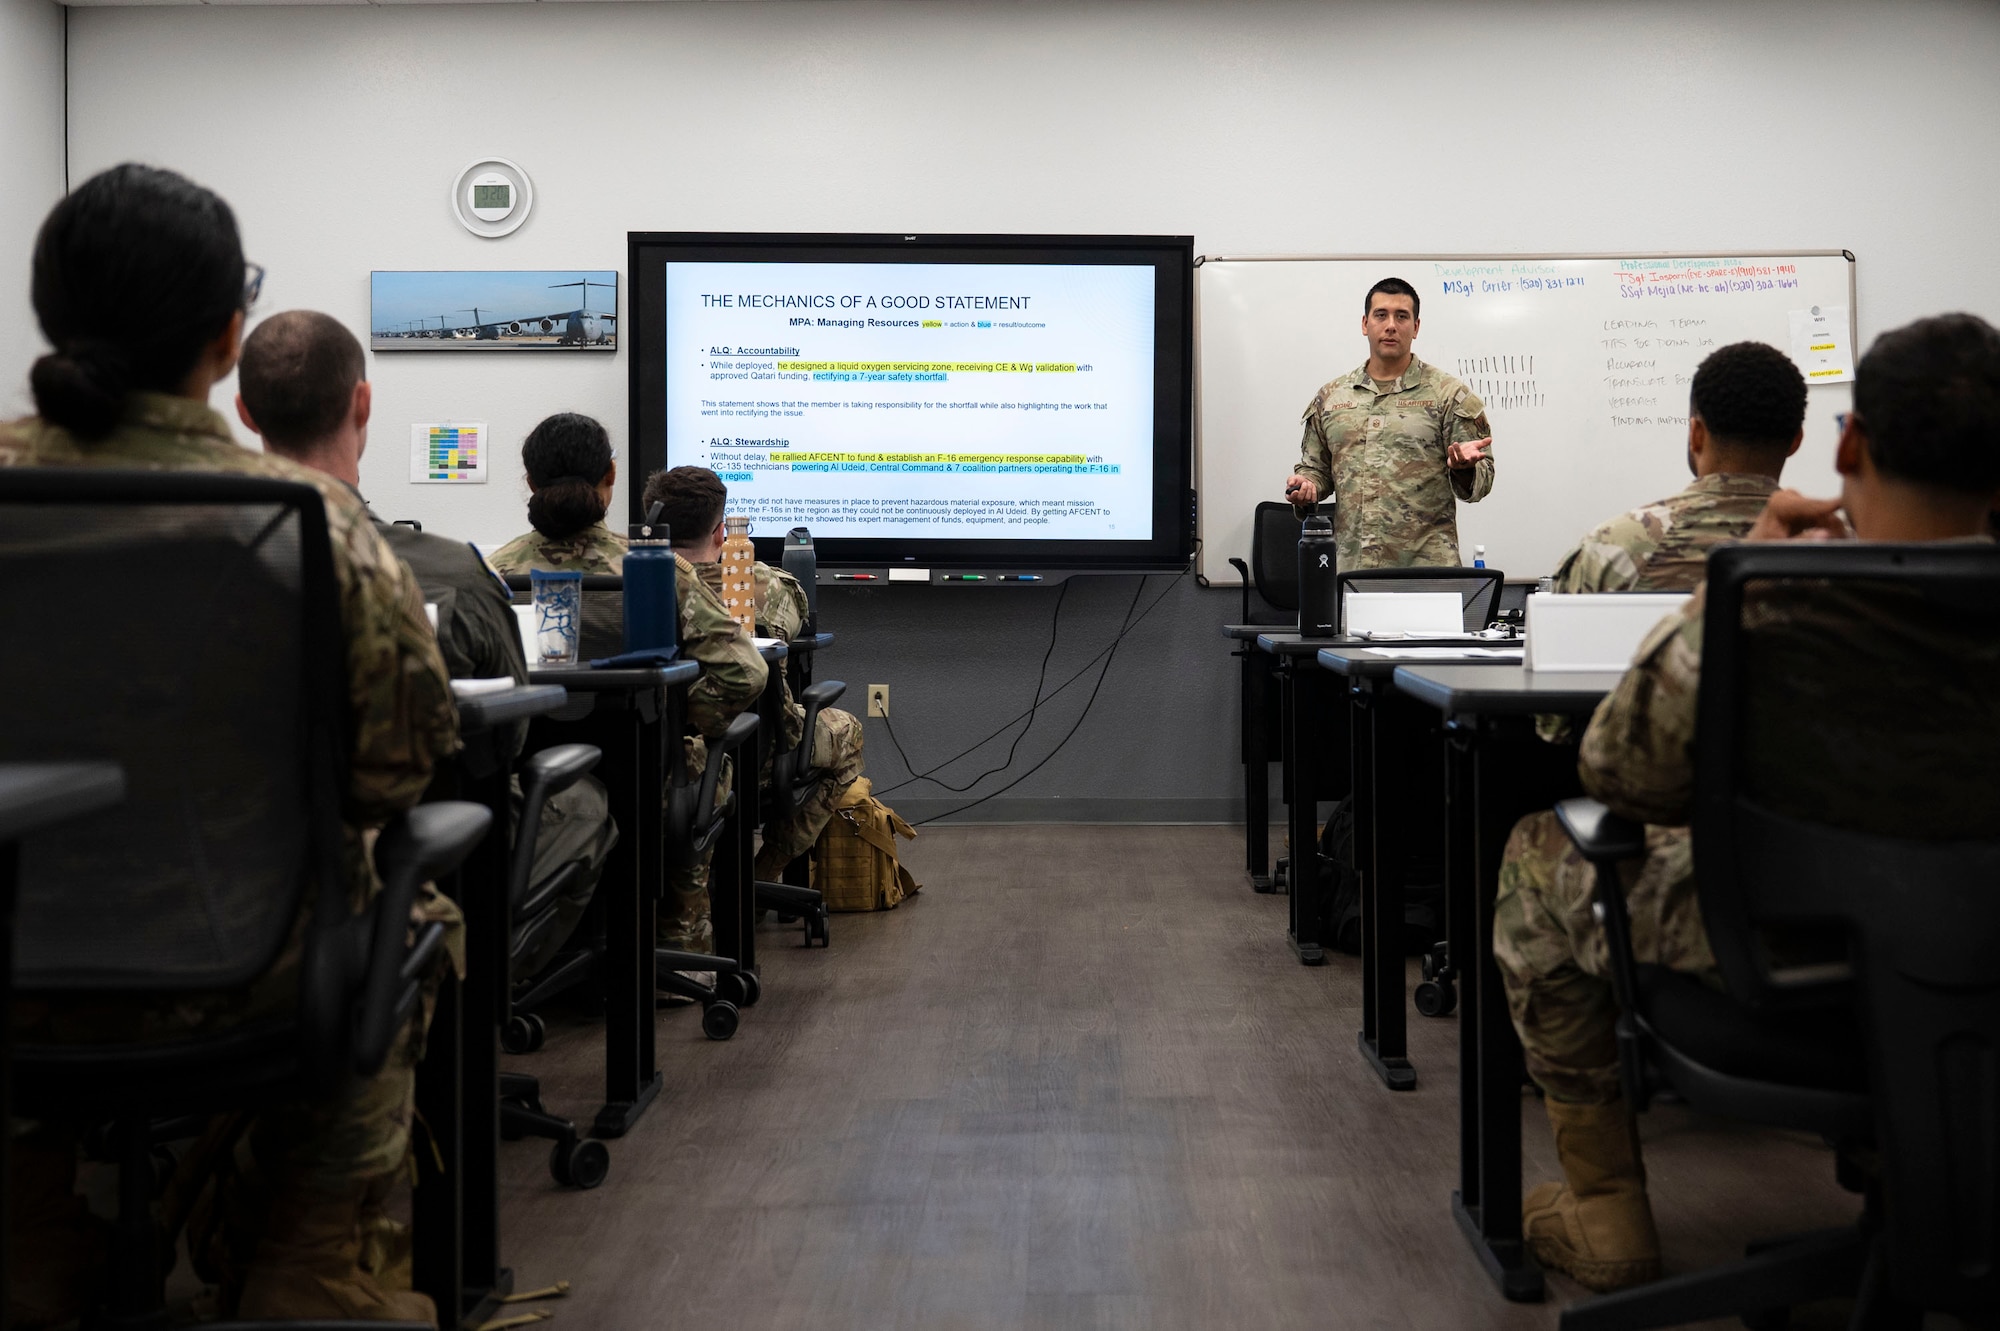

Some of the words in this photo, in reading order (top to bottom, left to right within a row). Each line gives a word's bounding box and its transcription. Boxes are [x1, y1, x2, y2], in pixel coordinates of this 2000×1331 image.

[1434, 264, 1504, 278] Development
[1613, 272, 1645, 287] TSgt
[1443, 281, 1474, 297] MSgt
[1620, 284, 1645, 299] SSgt
[701, 294, 732, 307] THE
[738, 295, 835, 307] MECHANICS
[840, 295, 862, 307] OF
[865, 295, 877, 308] A
[881, 295, 929, 308] GOOD
[935, 296, 1031, 309] STATEMENT
[789, 317, 814, 326] MPA:
[817, 318, 864, 328] Managing
[867, 318, 919, 326] Resources
[1603, 319, 1658, 331] LEADING
[710, 346, 732, 355] ALQ:
[737, 346, 799, 356] Accountability
[710, 361, 733, 369] While
[735, 361, 775, 371] deployed,
[789, 362, 827, 371] designed
[836, 362, 858, 370] liquid
[892, 362, 929, 372] servicing
[956, 363, 993, 372] receiving
[995, 363, 1008, 371] CE
[1011, 363, 1016, 371] &
[1018, 363, 1033, 372] Wg
[1035, 363, 1074, 371] validation
[710, 372, 748, 380] approved
[750, 371, 775, 379] Qatari
[777, 372, 810, 381] funding,
[812, 372, 849, 381] rectifying
[860, 372, 885, 381] 7-year
[887, 372, 912, 382] safety
[914, 372, 949, 380] shortfall.
[850, 401, 873, 409] taking
[874, 401, 922, 409] responsibility
[1017, 402, 1059, 410] highlighting
[735, 409, 768, 417] rectifying
[1610, 415, 1652, 427] FINDING
[710, 437, 732, 446] ALQ:
[735, 438, 789, 447] Stewardship
[710, 452, 741, 460] Without
[743, 453, 767, 463] delay,
[769, 453, 779, 461] he
[808, 453, 845, 461] AFCENT
[857, 453, 875, 461] fund
[878, 453, 883, 461] &
[937, 453, 956, 462] F-16
[958, 455, 1004, 464] emergency
[1045, 455, 1084, 465] capability
[1086, 455, 1102, 463] with
[710, 462, 741, 470] KC-135
[743, 461, 789, 470] technicians
[791, 462, 828, 472] powering
[841, 463, 867, 471] Udeid,
[870, 463, 899, 471] Central
[901, 463, 943, 471] Command
[946, 463, 952, 471] &
[962, 463, 996, 471] coalition
[998, 463, 1031, 473] partners
[1034, 463, 1072, 473] operating
[1074, 463, 1087, 472] the
[1089, 464, 1108, 472] F-16
[725, 471, 753, 481] region.
[740, 497, 756, 506] they
[850, 498, 870, 506] place
[880, 499, 908, 507] prevent
[806, 507, 830, 515] region
[842, 506, 858, 515] they
[905, 507, 951, 516] continuously
[952, 507, 986, 515] deployed
[1042, 508, 1067, 516] getting
[815, 514, 844, 522] showed
[882, 516, 930, 524] management
